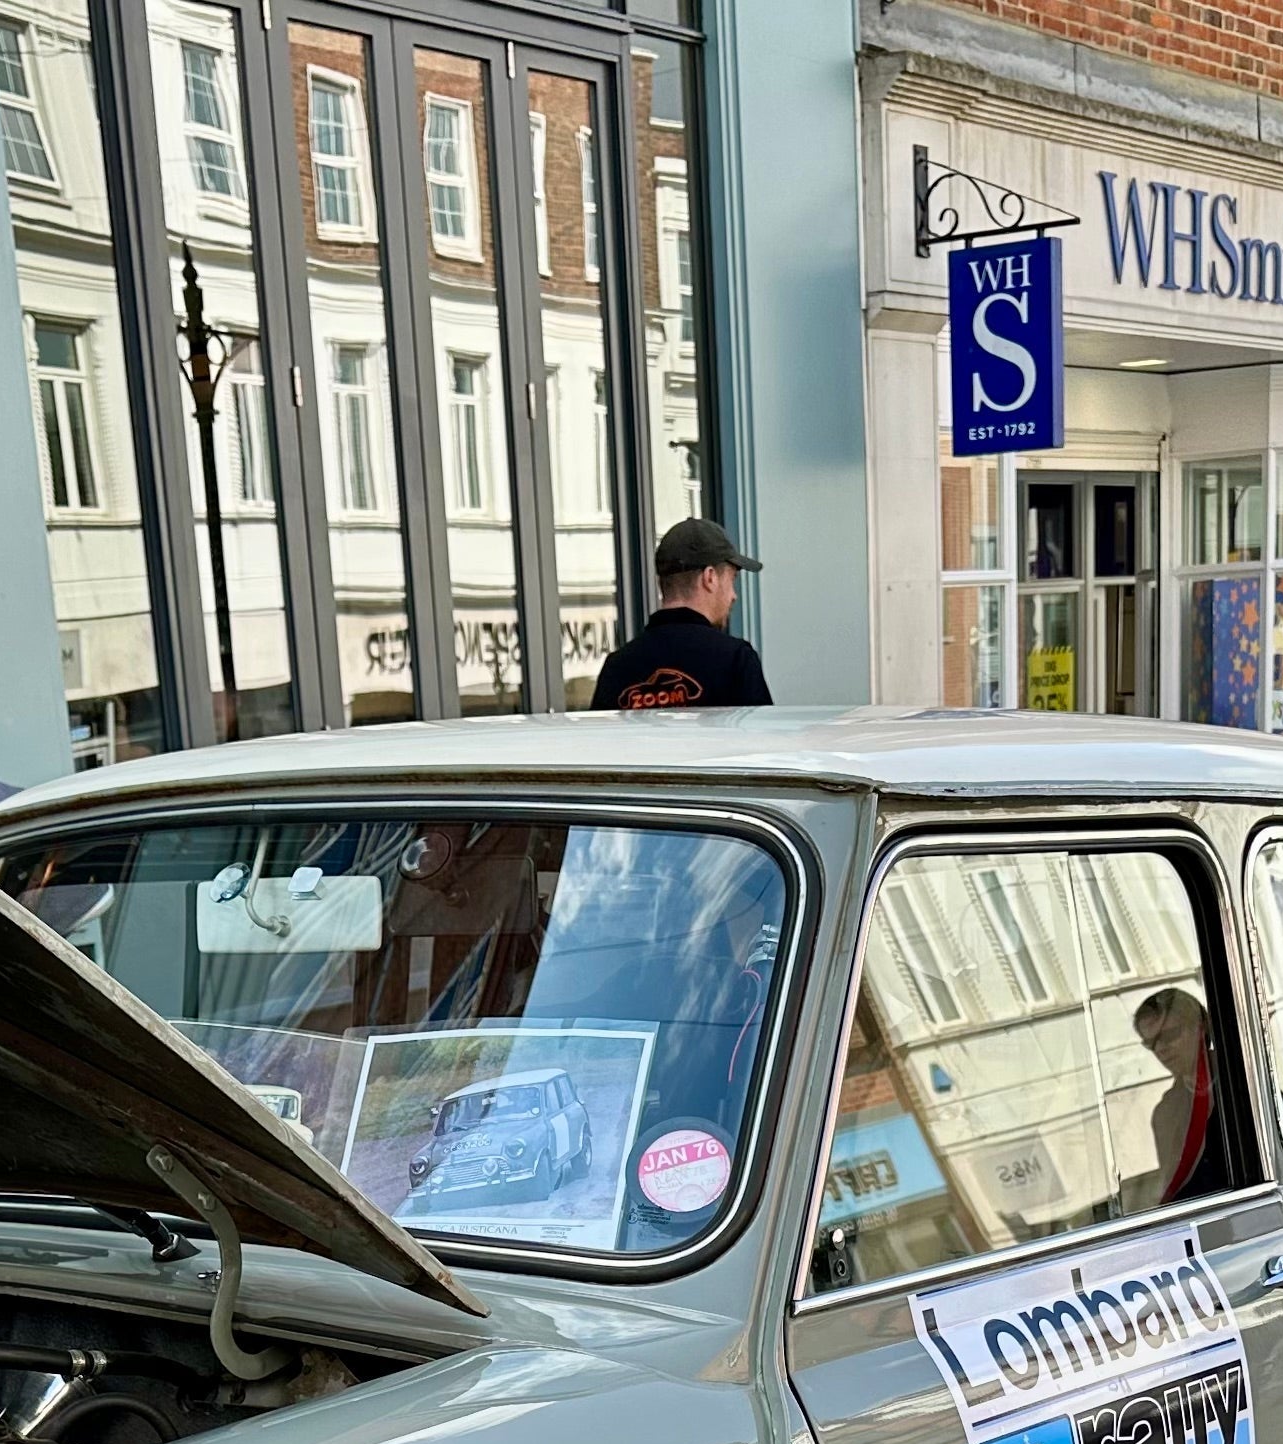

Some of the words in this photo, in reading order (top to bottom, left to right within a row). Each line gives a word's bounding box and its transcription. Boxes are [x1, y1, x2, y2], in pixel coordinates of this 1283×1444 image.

[968, 254, 1033, 294] WH
[972, 291, 1037, 413] S
[631, 690, 685, 709] ZOOM
[643, 1146, 688, 1172] JAN
[692, 1139, 719, 1158] 76
[921, 1238, 1230, 1408] Lombard
